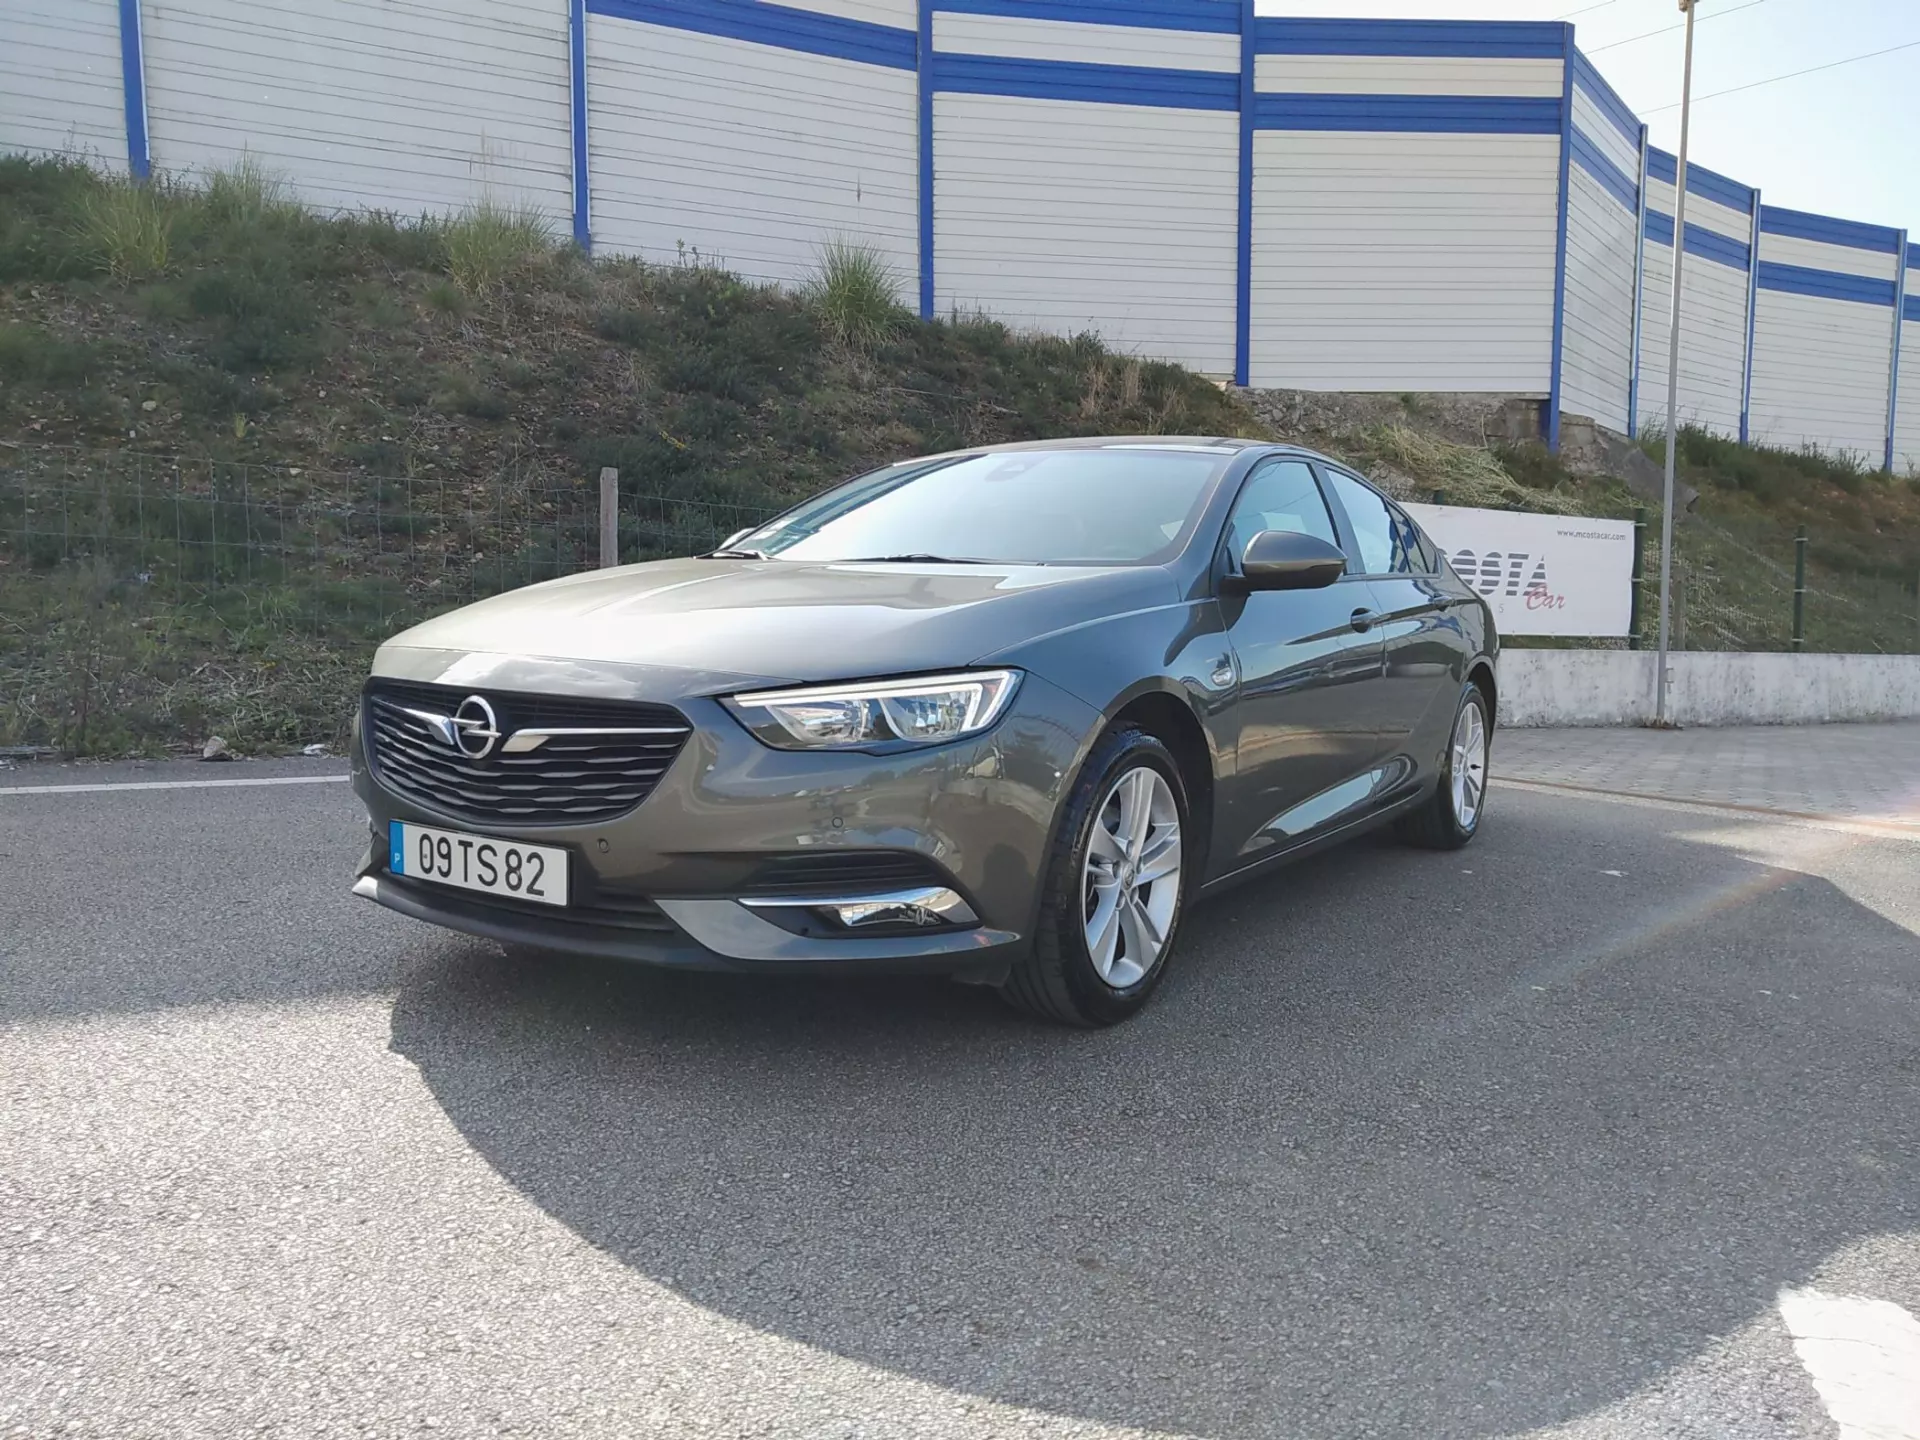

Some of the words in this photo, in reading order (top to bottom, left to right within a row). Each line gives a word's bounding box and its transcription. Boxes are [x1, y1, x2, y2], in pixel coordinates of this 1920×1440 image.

[1556, 529, 1626, 541] www.mcostacar.com
[1437, 548, 1547, 596] OSTA
[1526, 583, 1566, 610] Car
[394, 852, 401, 864] P
